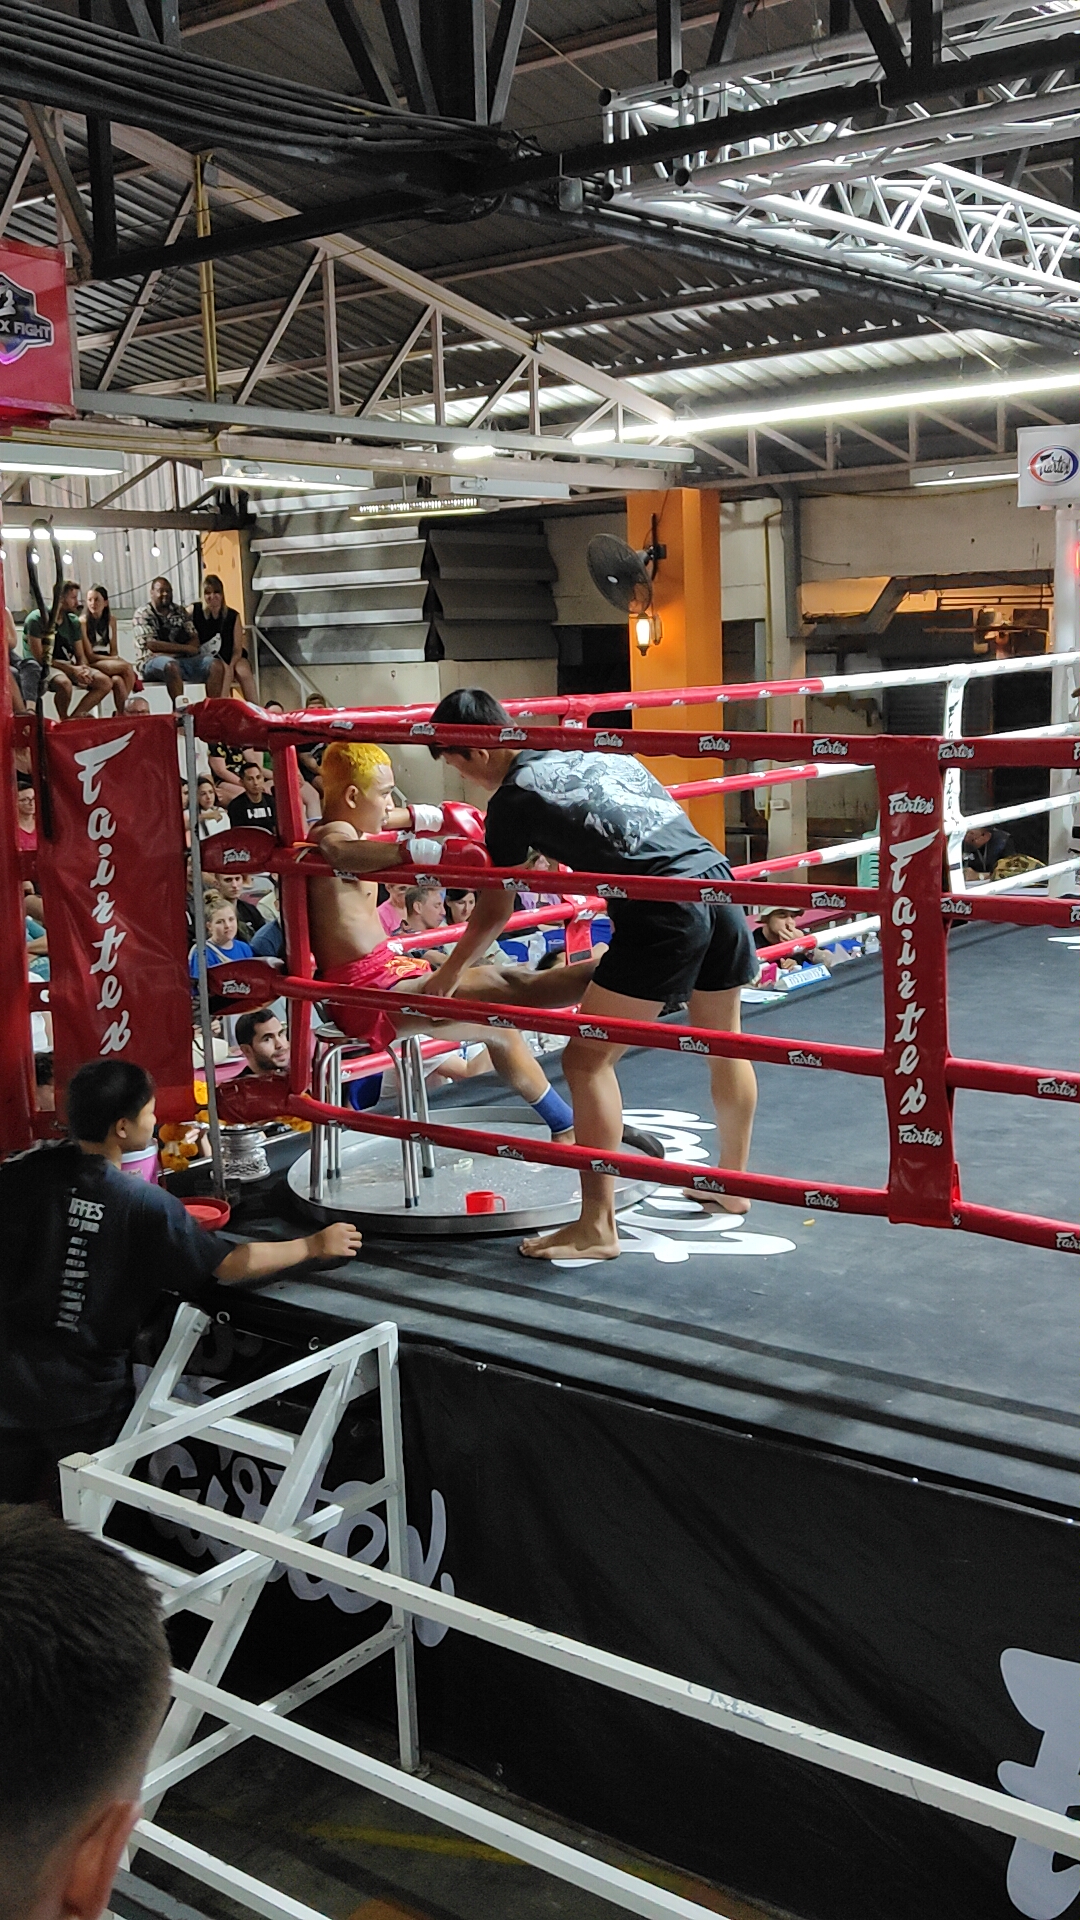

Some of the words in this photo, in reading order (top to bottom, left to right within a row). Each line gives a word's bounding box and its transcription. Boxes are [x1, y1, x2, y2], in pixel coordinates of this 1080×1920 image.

[14, 321, 51, 339] FIGHT
[699, 736, 730, 752] Fairtex
[812, 738, 848, 756] Fairtex
[938, 743, 974, 760] Fairtex
[888, 792, 934, 815] Fairtex
[74, 729, 136, 1055] Fairtex
[700, 887, 732, 903] Fairtex
[811, 891, 846, 908] Fairtex
[889, 829, 940, 1115] Fairtex
[678, 1036, 710, 1053] Fairtex
[788, 1050, 822, 1067] Fairtex
[1037, 1078, 1077, 1097] Fairtex
[898, 1124, 943, 1147] Fairtex
[693, 1176, 725, 1193] Fairtex
[804, 1190, 839, 1209] Fairtex
